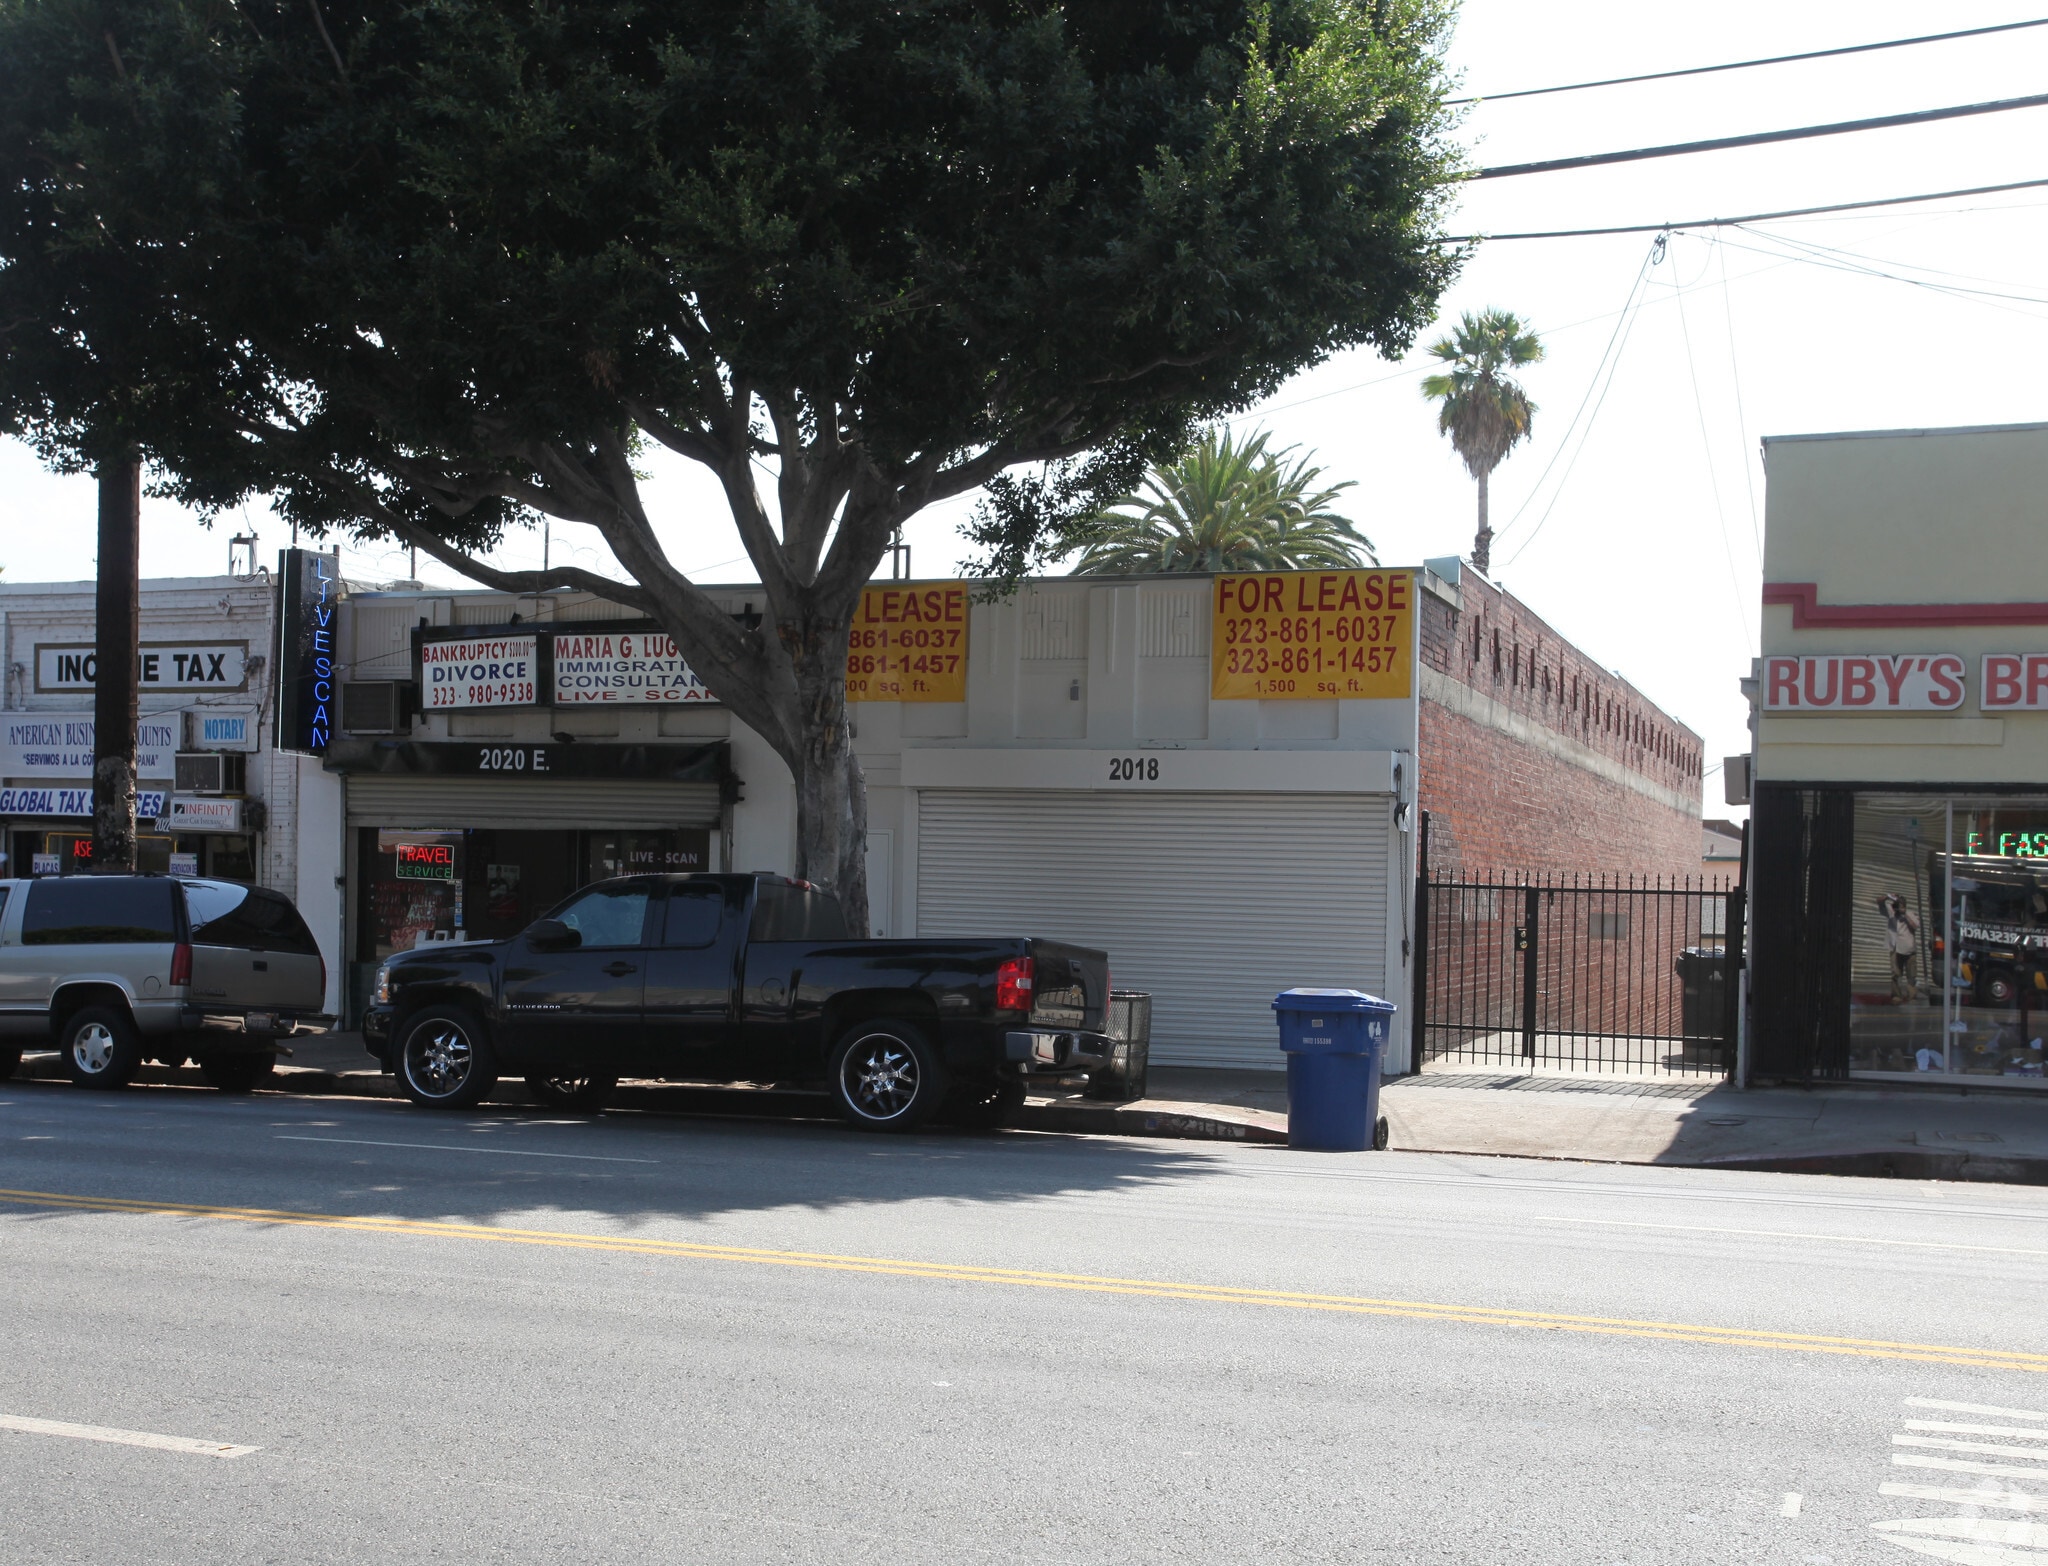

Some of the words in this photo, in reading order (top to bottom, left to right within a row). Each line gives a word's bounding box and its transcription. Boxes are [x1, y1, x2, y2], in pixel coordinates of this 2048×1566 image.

[1219, 576, 1284, 613] FOR
[1297, 574, 1407, 612] LEASE
[864, 590, 963, 623] LEASE
[1225, 615, 1397, 644] 323-861-6037
[423, 642, 508, 663] BANKRUPTCY
[555, 637, 614, 659] MARIA
[619, 636, 638, 659] G.
[172, 653, 226, 682] TAX
[1227, 646, 1397, 674] 323-861-1457
[432, 661, 527, 683] DIVORCE
[1768, 657, 1963, 707] RUBY'S
[468, 681, 533, 705] 980-9538
[557, 690, 618, 702] LIVE
[879, 681, 905, 695] sq.
[912, 679, 931, 692] ft.
[1254, 679, 1296, 695] 1,500
[1317, 680, 1341, 695] sq.
[1347, 678, 1364, 692] ft.
[8, 723, 62, 746] AMERICAN
[204, 718, 245, 741] NOTARY
[62, 754, 68, 766] A
[70, 754, 79, 766] LA
[479, 748, 525, 771] 2020
[533, 749, 550, 771] E.
[1109, 757, 1159, 781] 2018
[0, 790, 54, 813] GLOBAL
[59, 791, 87, 814] TAX
[185, 803, 233, 816] INFINITY
[398, 845, 452, 864] TRAVEL
[629, 851, 654, 863] LIVE
[665, 852, 698, 864] SCAN
[398, 865, 452, 879] SERVICE
